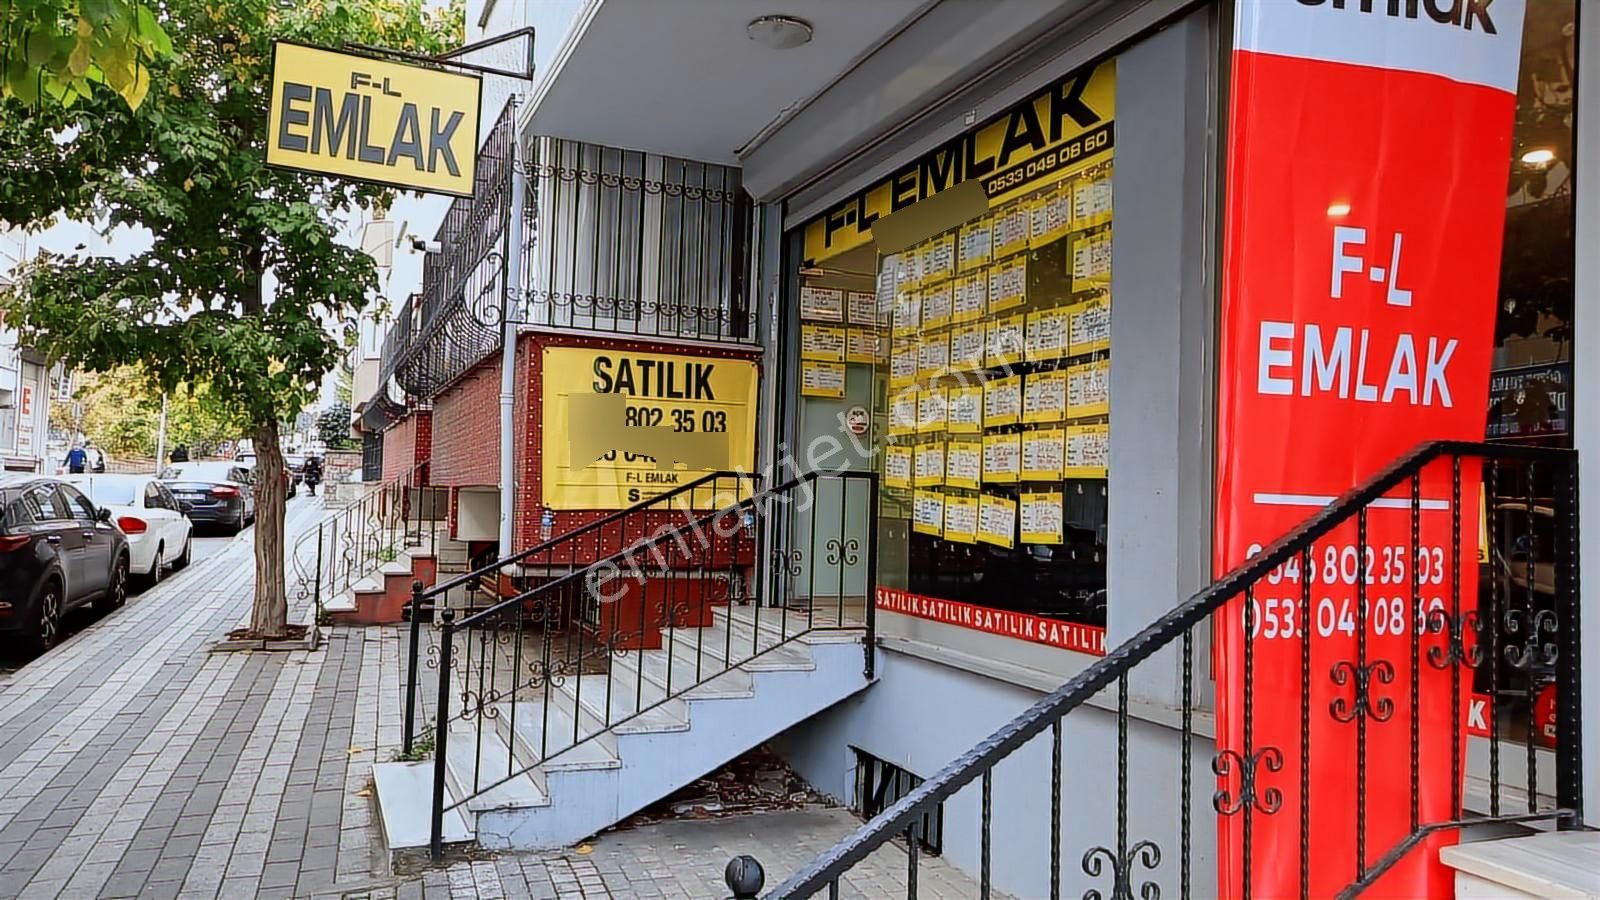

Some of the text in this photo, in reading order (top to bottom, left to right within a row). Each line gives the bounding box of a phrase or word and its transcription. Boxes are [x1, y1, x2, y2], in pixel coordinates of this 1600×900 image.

[351, 71, 401, 97] F-L
[278, 81, 465, 177] EMLAK
[890, 66, 1101, 213] EMLAK
[988, 168, 1023, 194] 0533
[1026, 153, 1056, 178] 049
[1084, 129, 1107, 152] 60
[1330, 225, 1413, 307] F-L
[592, 356, 714, 400] SATILIK
[1258, 321, 1459, 408] EMLAK
[671, 409, 695, 432] 35
[702, 410, 726, 432] 03
[626, 472, 678, 484] F-L EMLAK
[1380, 546, 1405, 584] 35
[877, 589, 919, 614] SATILIK
[921, 602, 971, 625] SATILIK
[975, 608, 1033, 638] SATILIK
[1374, 597, 1405, 636] 08
